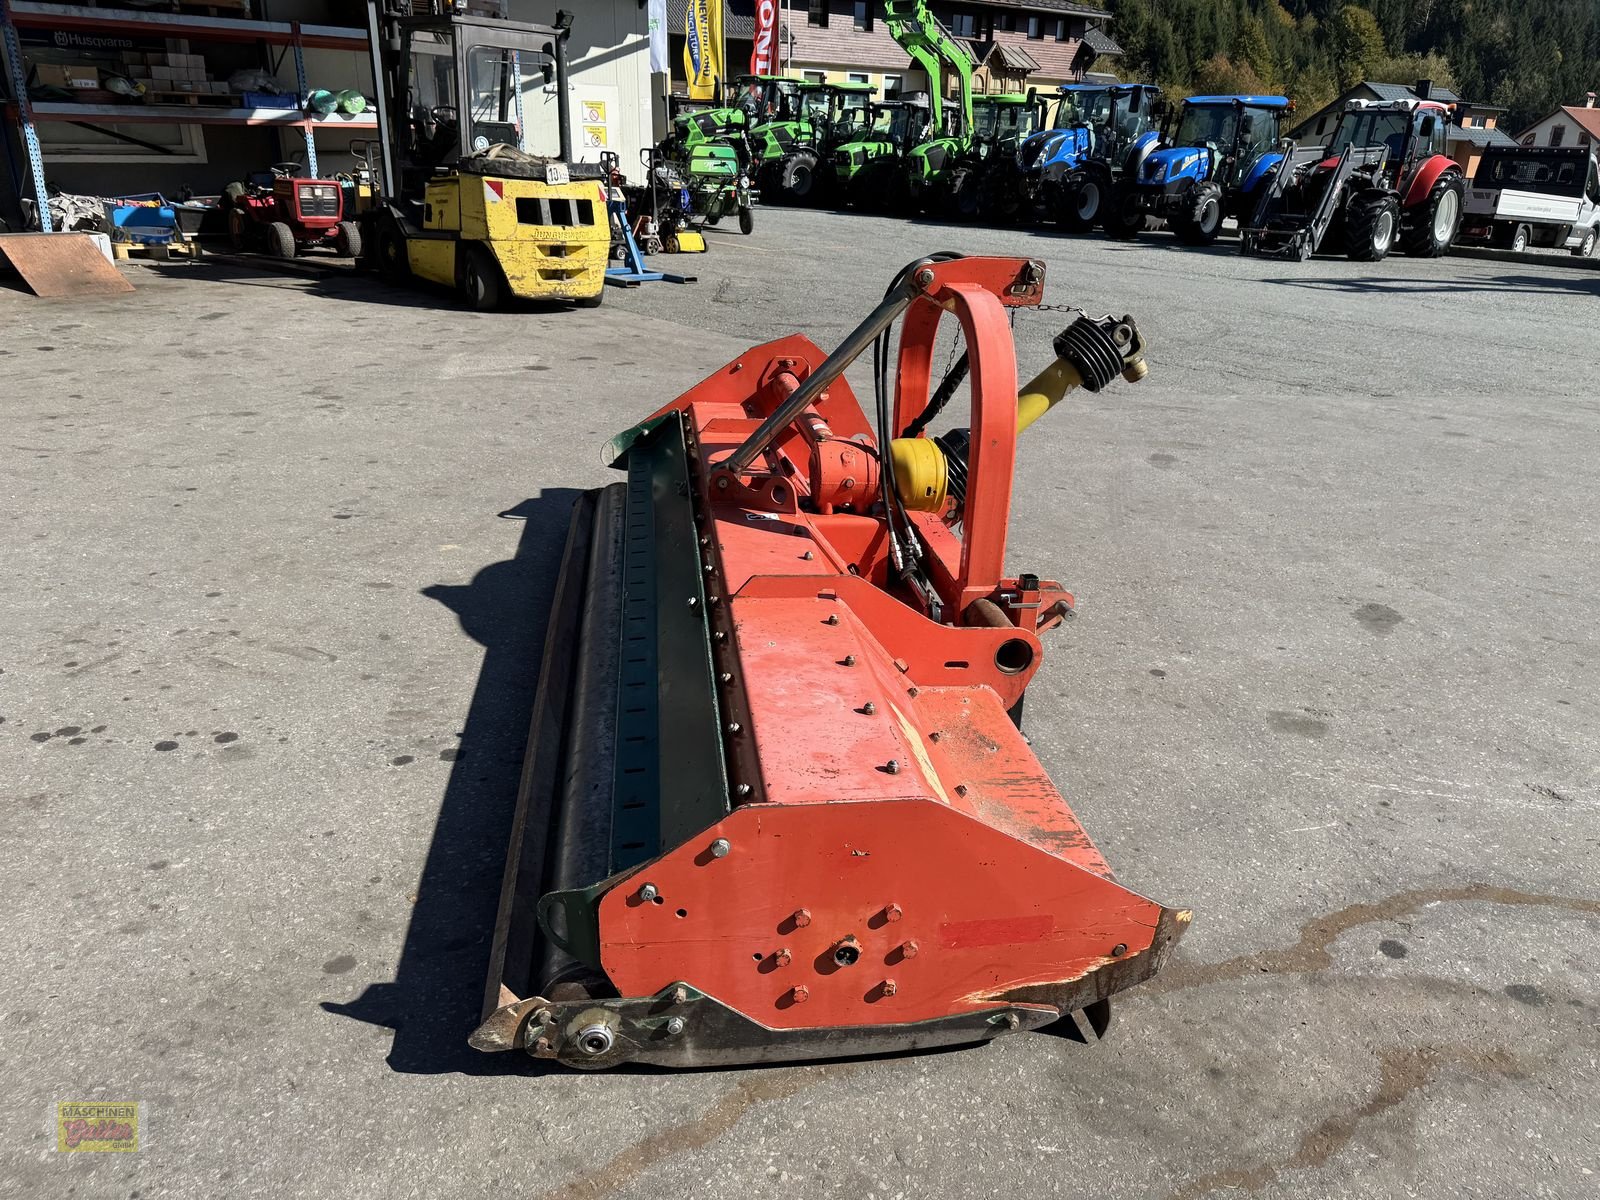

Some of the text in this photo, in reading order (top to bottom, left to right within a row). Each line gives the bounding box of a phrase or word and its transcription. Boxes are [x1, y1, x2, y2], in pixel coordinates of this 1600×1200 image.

[68, 33, 133, 48] Husqvarna
[698, 0, 711, 77] NEW HOLLAND
